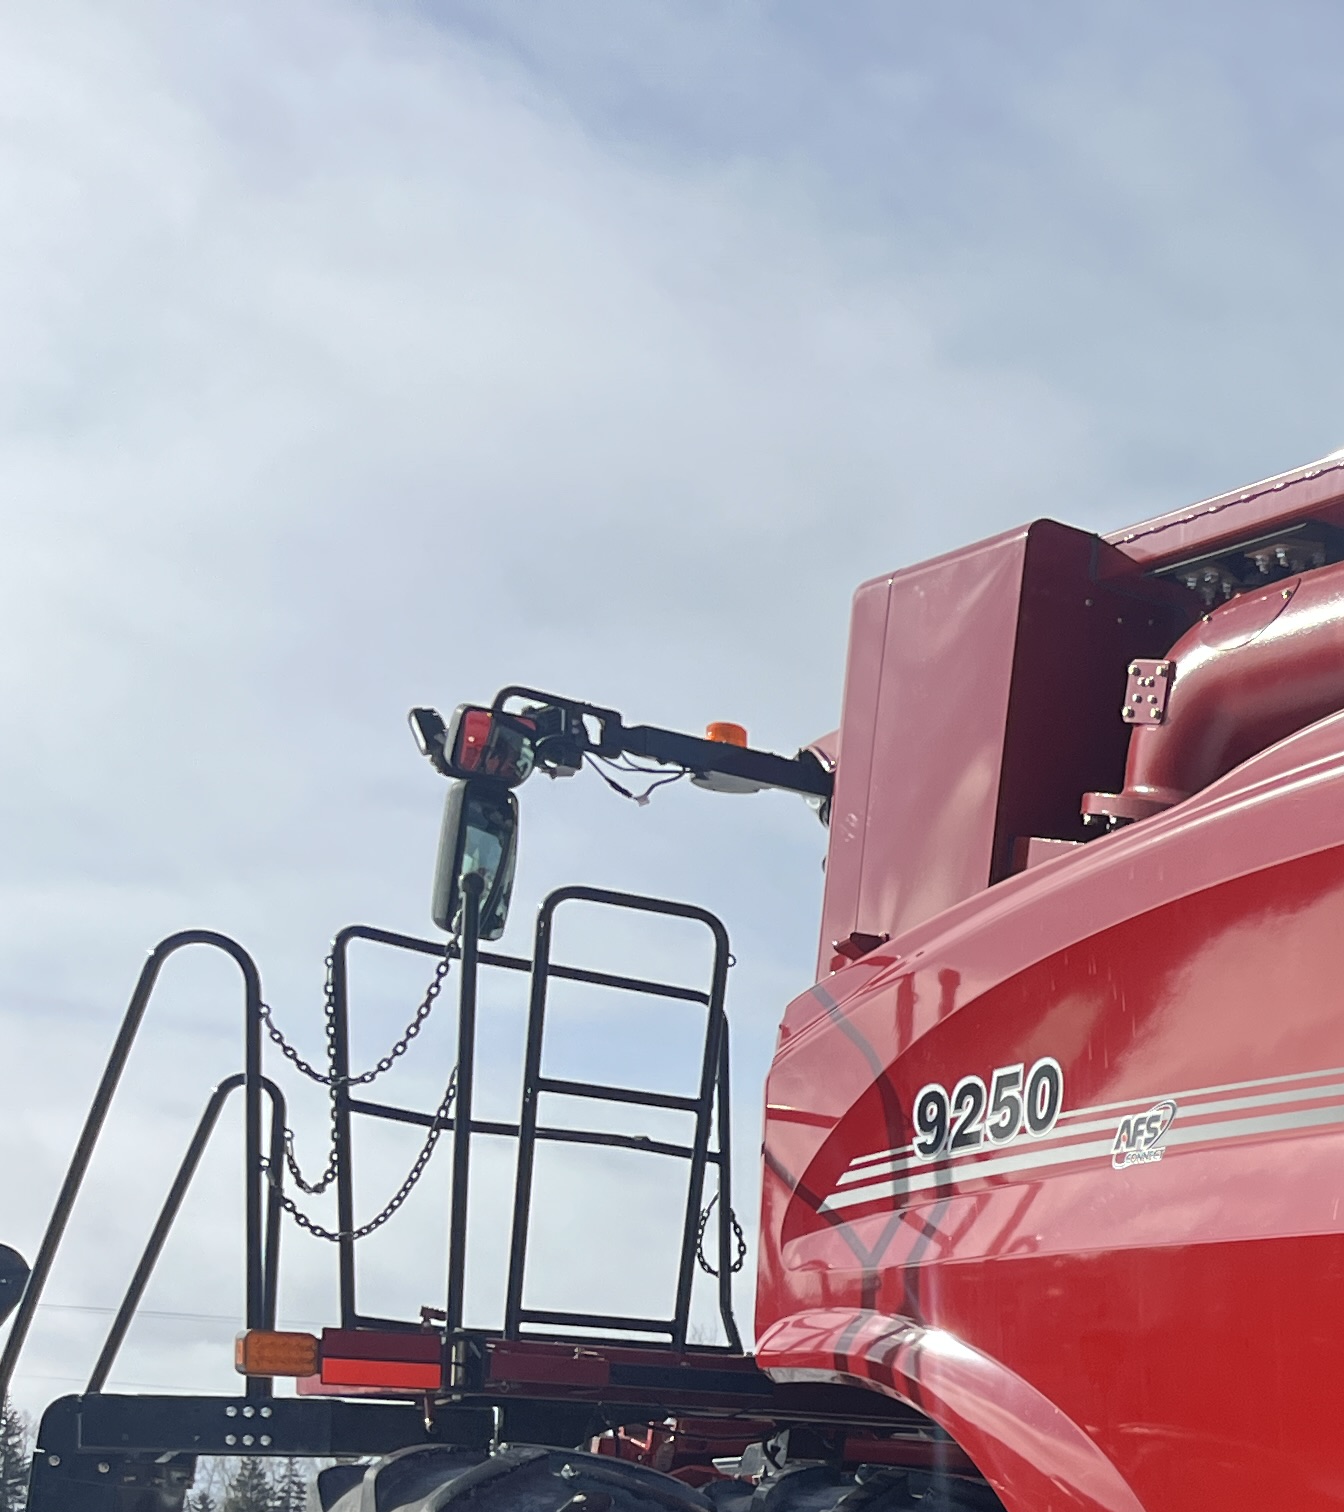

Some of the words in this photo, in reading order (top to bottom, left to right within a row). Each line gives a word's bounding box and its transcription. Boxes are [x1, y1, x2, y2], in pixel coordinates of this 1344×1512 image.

[913, 1056, 1064, 1161] 9250
[1113, 1113, 1163, 1151] AFS
[1126, 1148, 1165, 1164] CONNECT
